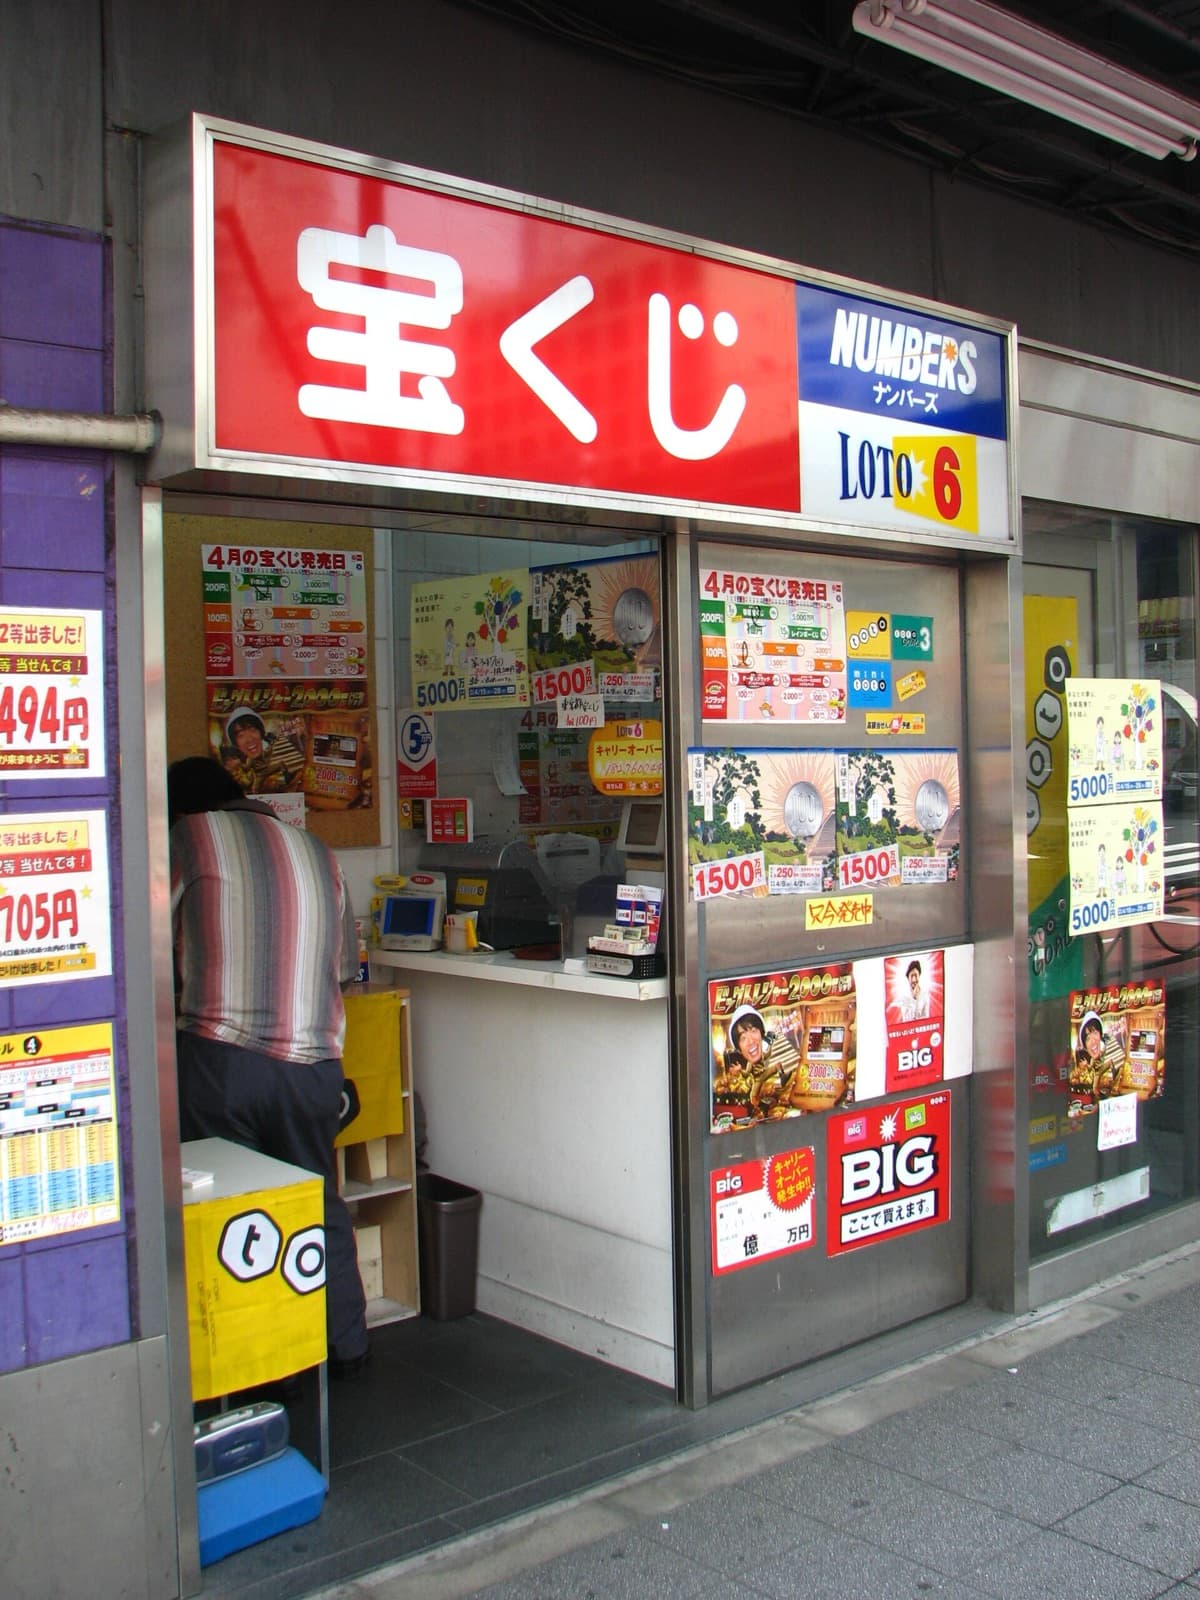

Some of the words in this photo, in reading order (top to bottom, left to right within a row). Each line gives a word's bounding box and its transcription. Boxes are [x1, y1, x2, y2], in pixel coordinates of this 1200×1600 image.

[297, 224, 747, 461] 宝くじ
[830, 308, 977, 395] NUMBERS
[873, 381, 939, 414] ナンバーズ
[838, 431, 912, 500] LOTO
[933, 446, 961, 520] 6
[207, 546, 346, 570] 4月の宝くじ発売日
[704, 571, 828, 602] 4月の宝くじ発売日
[850, 616, 888, 650] toto
[920, 627, 930, 652] 3
[854, 670, 884, 679] mini
[854, 680, 886, 691] toto
[0, 685, 89, 745] 494円
[0, 830, 79, 847] 等出ました!
[754, 858, 762, 878] 万円
[776, 867, 793, 878] 250
[908, 858, 923, 869] 250
[0, 888, 79, 943] 705円
[897, 1047, 933, 1072] BIG
[774, 1152, 806, 1174] キャリー
[841, 1136, 937, 1205] BIG
[775, 1166, 809, 1189] オーバー
[849, 1198, 930, 1234] ここで買えます。
[743, 1233, 759, 1257] 億
[786, 1223, 809, 1244] 万円
